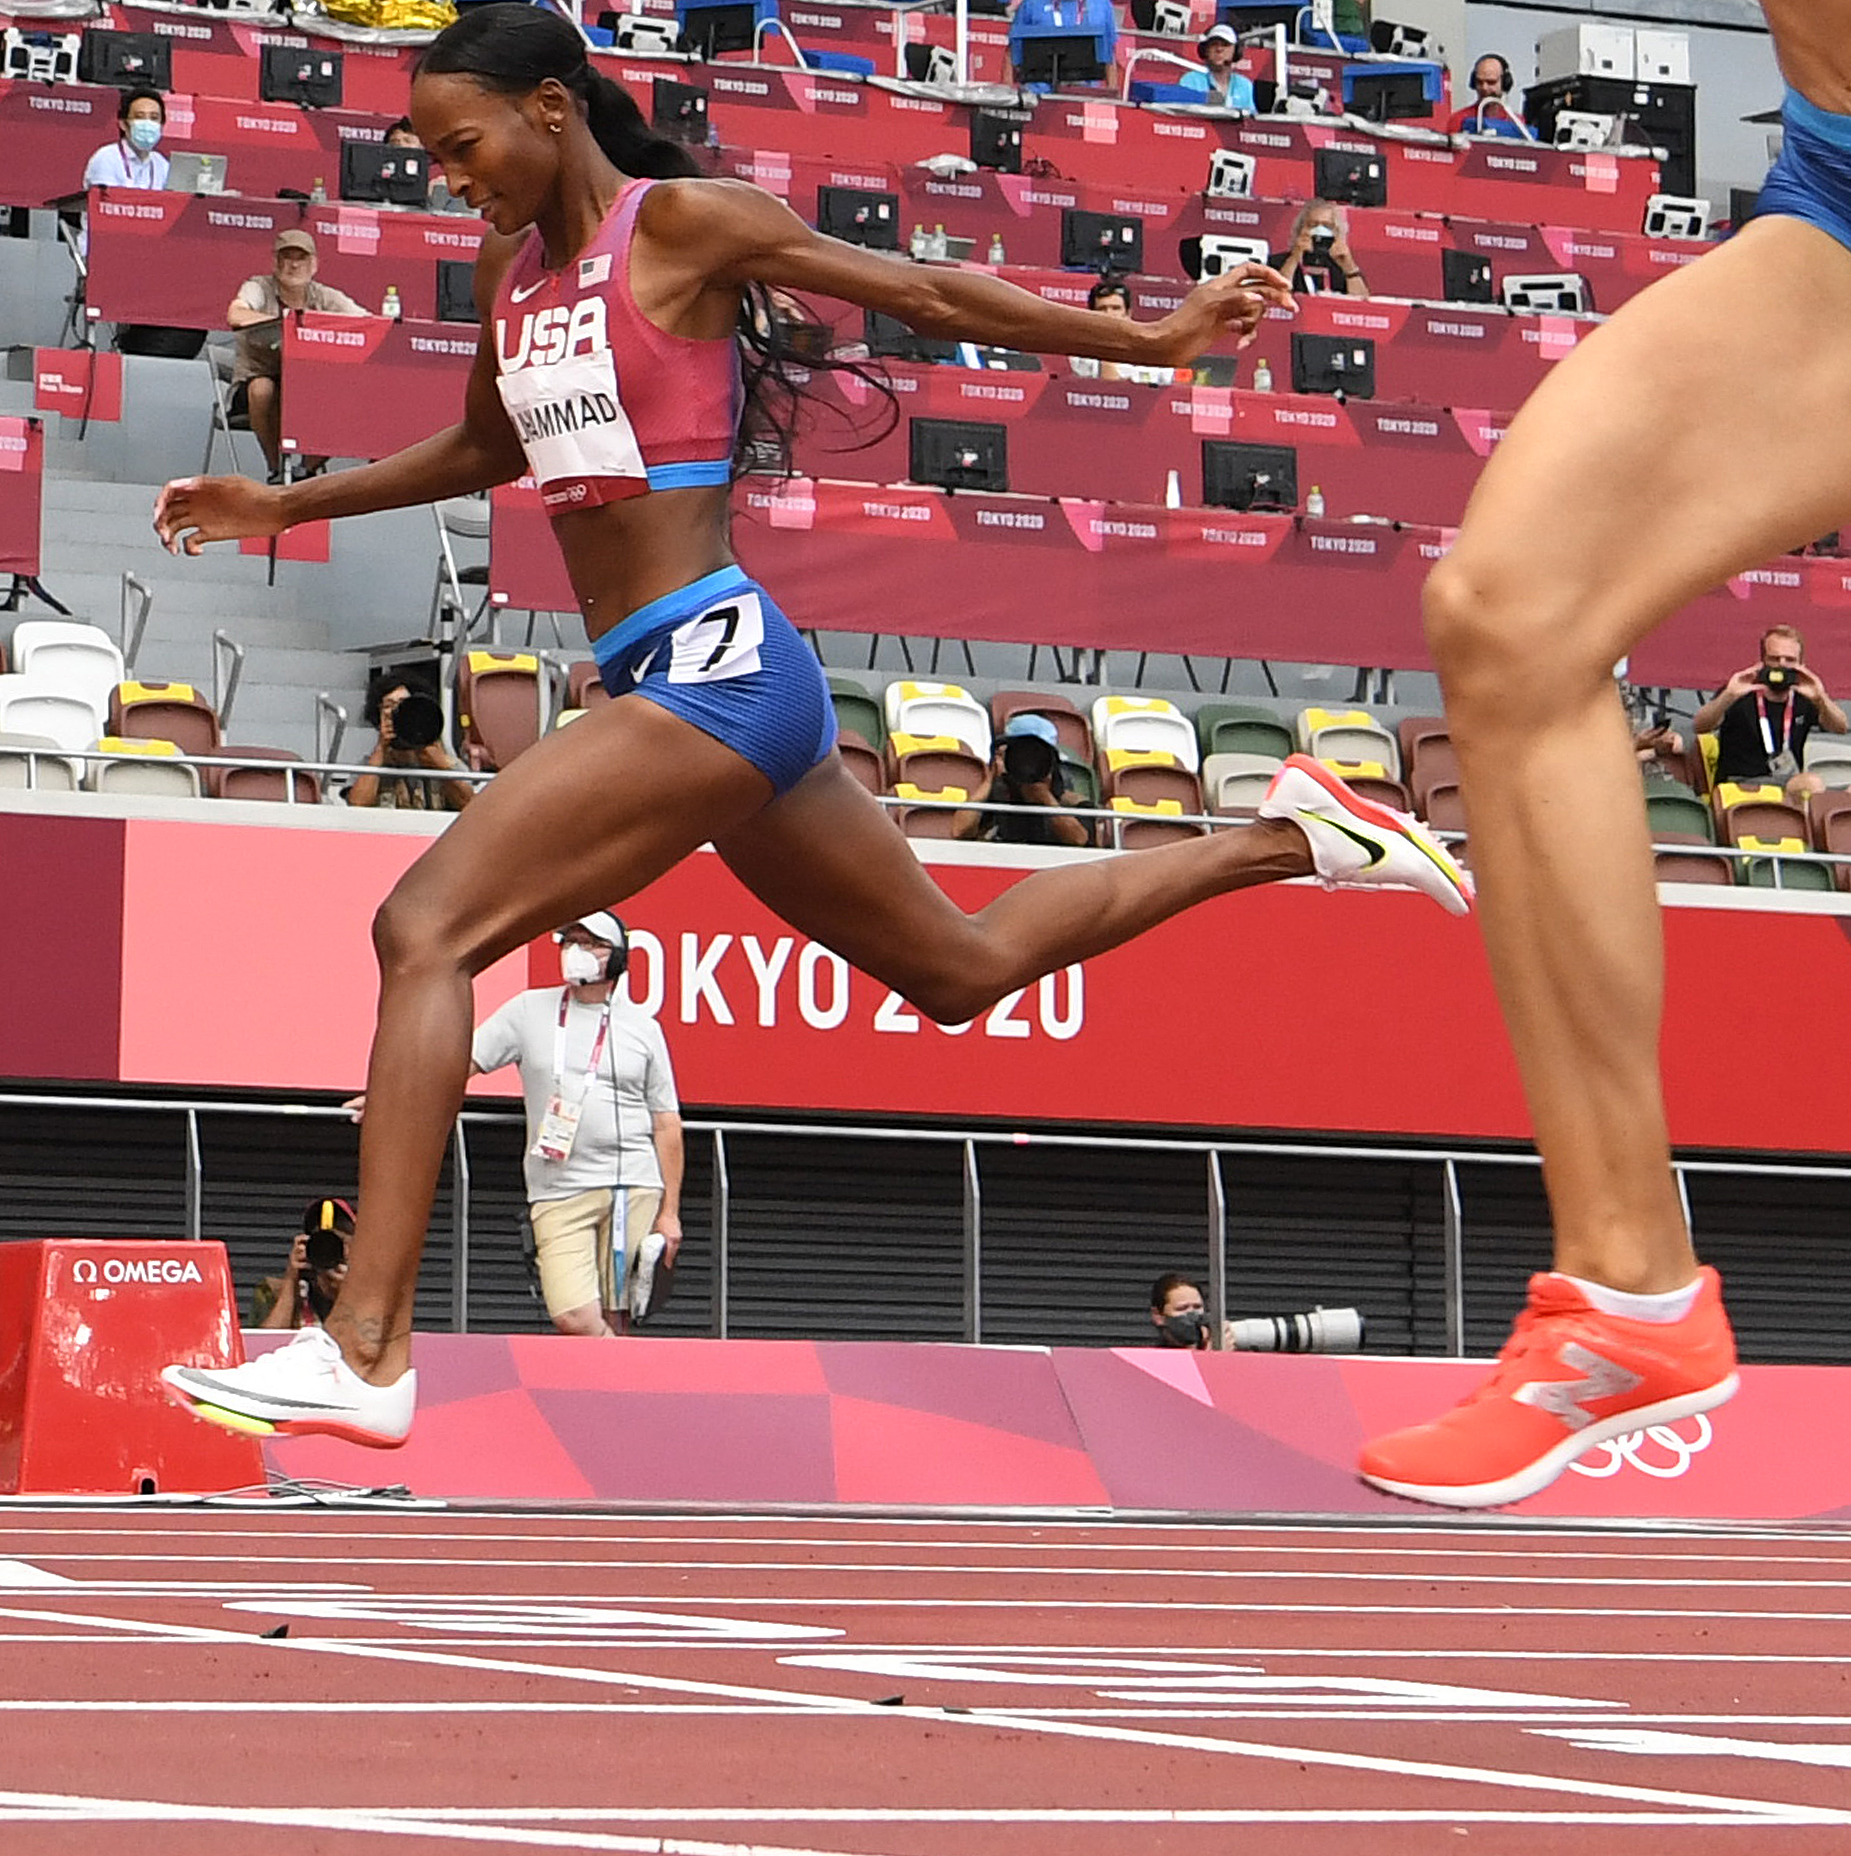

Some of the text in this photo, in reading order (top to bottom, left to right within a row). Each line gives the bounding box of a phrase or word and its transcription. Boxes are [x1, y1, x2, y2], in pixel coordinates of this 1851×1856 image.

[497, 296, 609, 372] USA
[696, 606, 740, 672] 7
[618, 929, 850, 1030] OKYO
[105, 1260, 202, 1284] OMEGA
